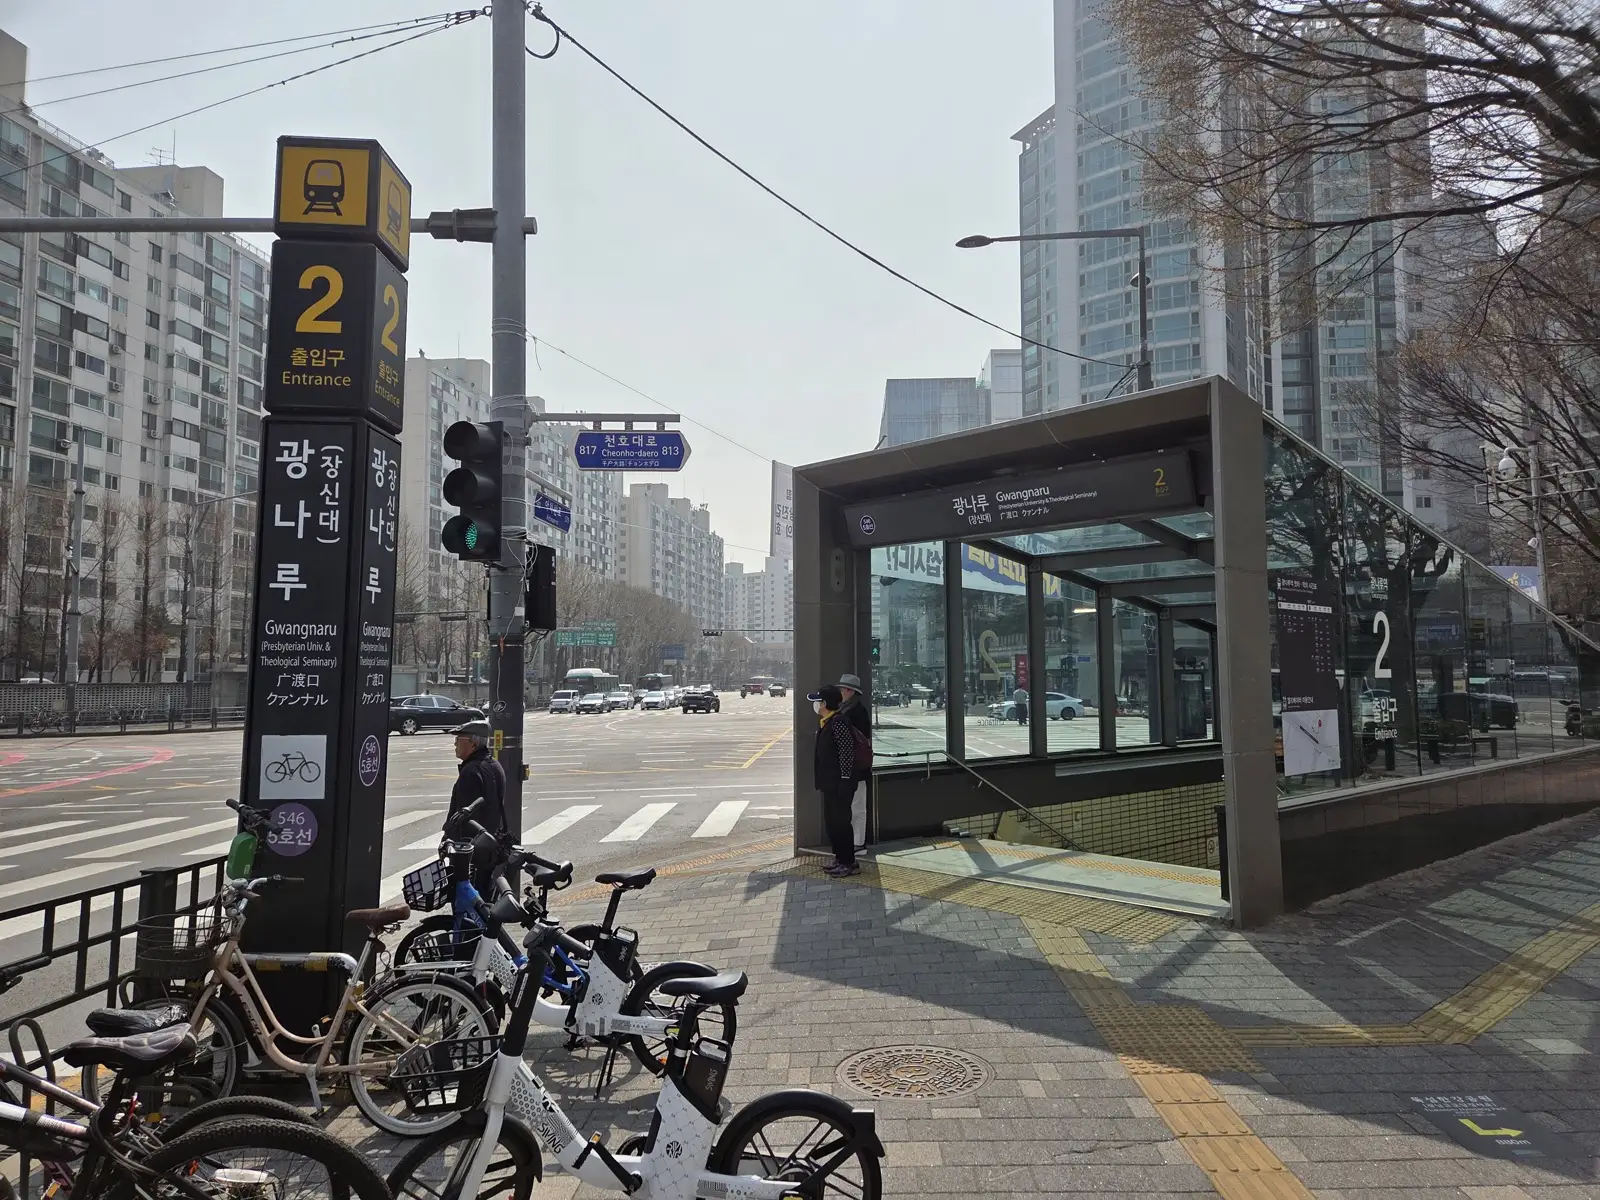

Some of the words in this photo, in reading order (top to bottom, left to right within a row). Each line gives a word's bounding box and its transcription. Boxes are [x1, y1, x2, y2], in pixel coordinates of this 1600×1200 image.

[295, 264, 344, 334] 2
[381, 284, 399, 357] 2
[290, 348, 345, 367] 출입구
[282, 371, 352, 388] Entrance
[378, 359, 399, 388] 출입구
[374, 380, 400, 408] Entrance
[604, 434, 658, 447] 천호대로
[579, 445, 597, 455] 817
[601, 448, 659, 457] Cheonho-daero
[661, 446, 680, 456] 813
[1153, 467, 1166, 486] 2
[316, 445, 345, 544] (장신대)
[995, 486, 1050, 502] Gwangnaru
[1024, 499, 1045, 508] University
[1049, 495, 1074, 504] Theological
[1074, 490, 1098, 500] Seminary)
[384, 459, 398, 552] (장신대)
[952, 494, 989, 516] 광나루
[269, 439, 315, 602] 광나루
[365, 447, 388, 604] 광나루
[968, 512, 992, 525] (장신대)
[265, 619, 337, 639] Gwangnaru
[363, 621, 391, 641] Gwangnaru
[261, 641, 306, 653] (Presbyterian
[306, 641, 324, 652] Univ.
[325, 642, 331, 651] &
[1373, 610, 1392, 678] 2
[260, 656, 301, 668] Theological
[302, 656, 337, 669] Seminary)
[277, 672, 320, 688] 广渡口
[266, 692, 328, 706] クァンナル
[1372, 697, 1397, 722] 출입구
[1374, 727, 1398, 740] Entrance
[365, 742, 376, 755] 546
[361, 757, 378, 773] 5호선
[277, 811, 305, 825] 546
[267, 828, 312, 845] 5호선
